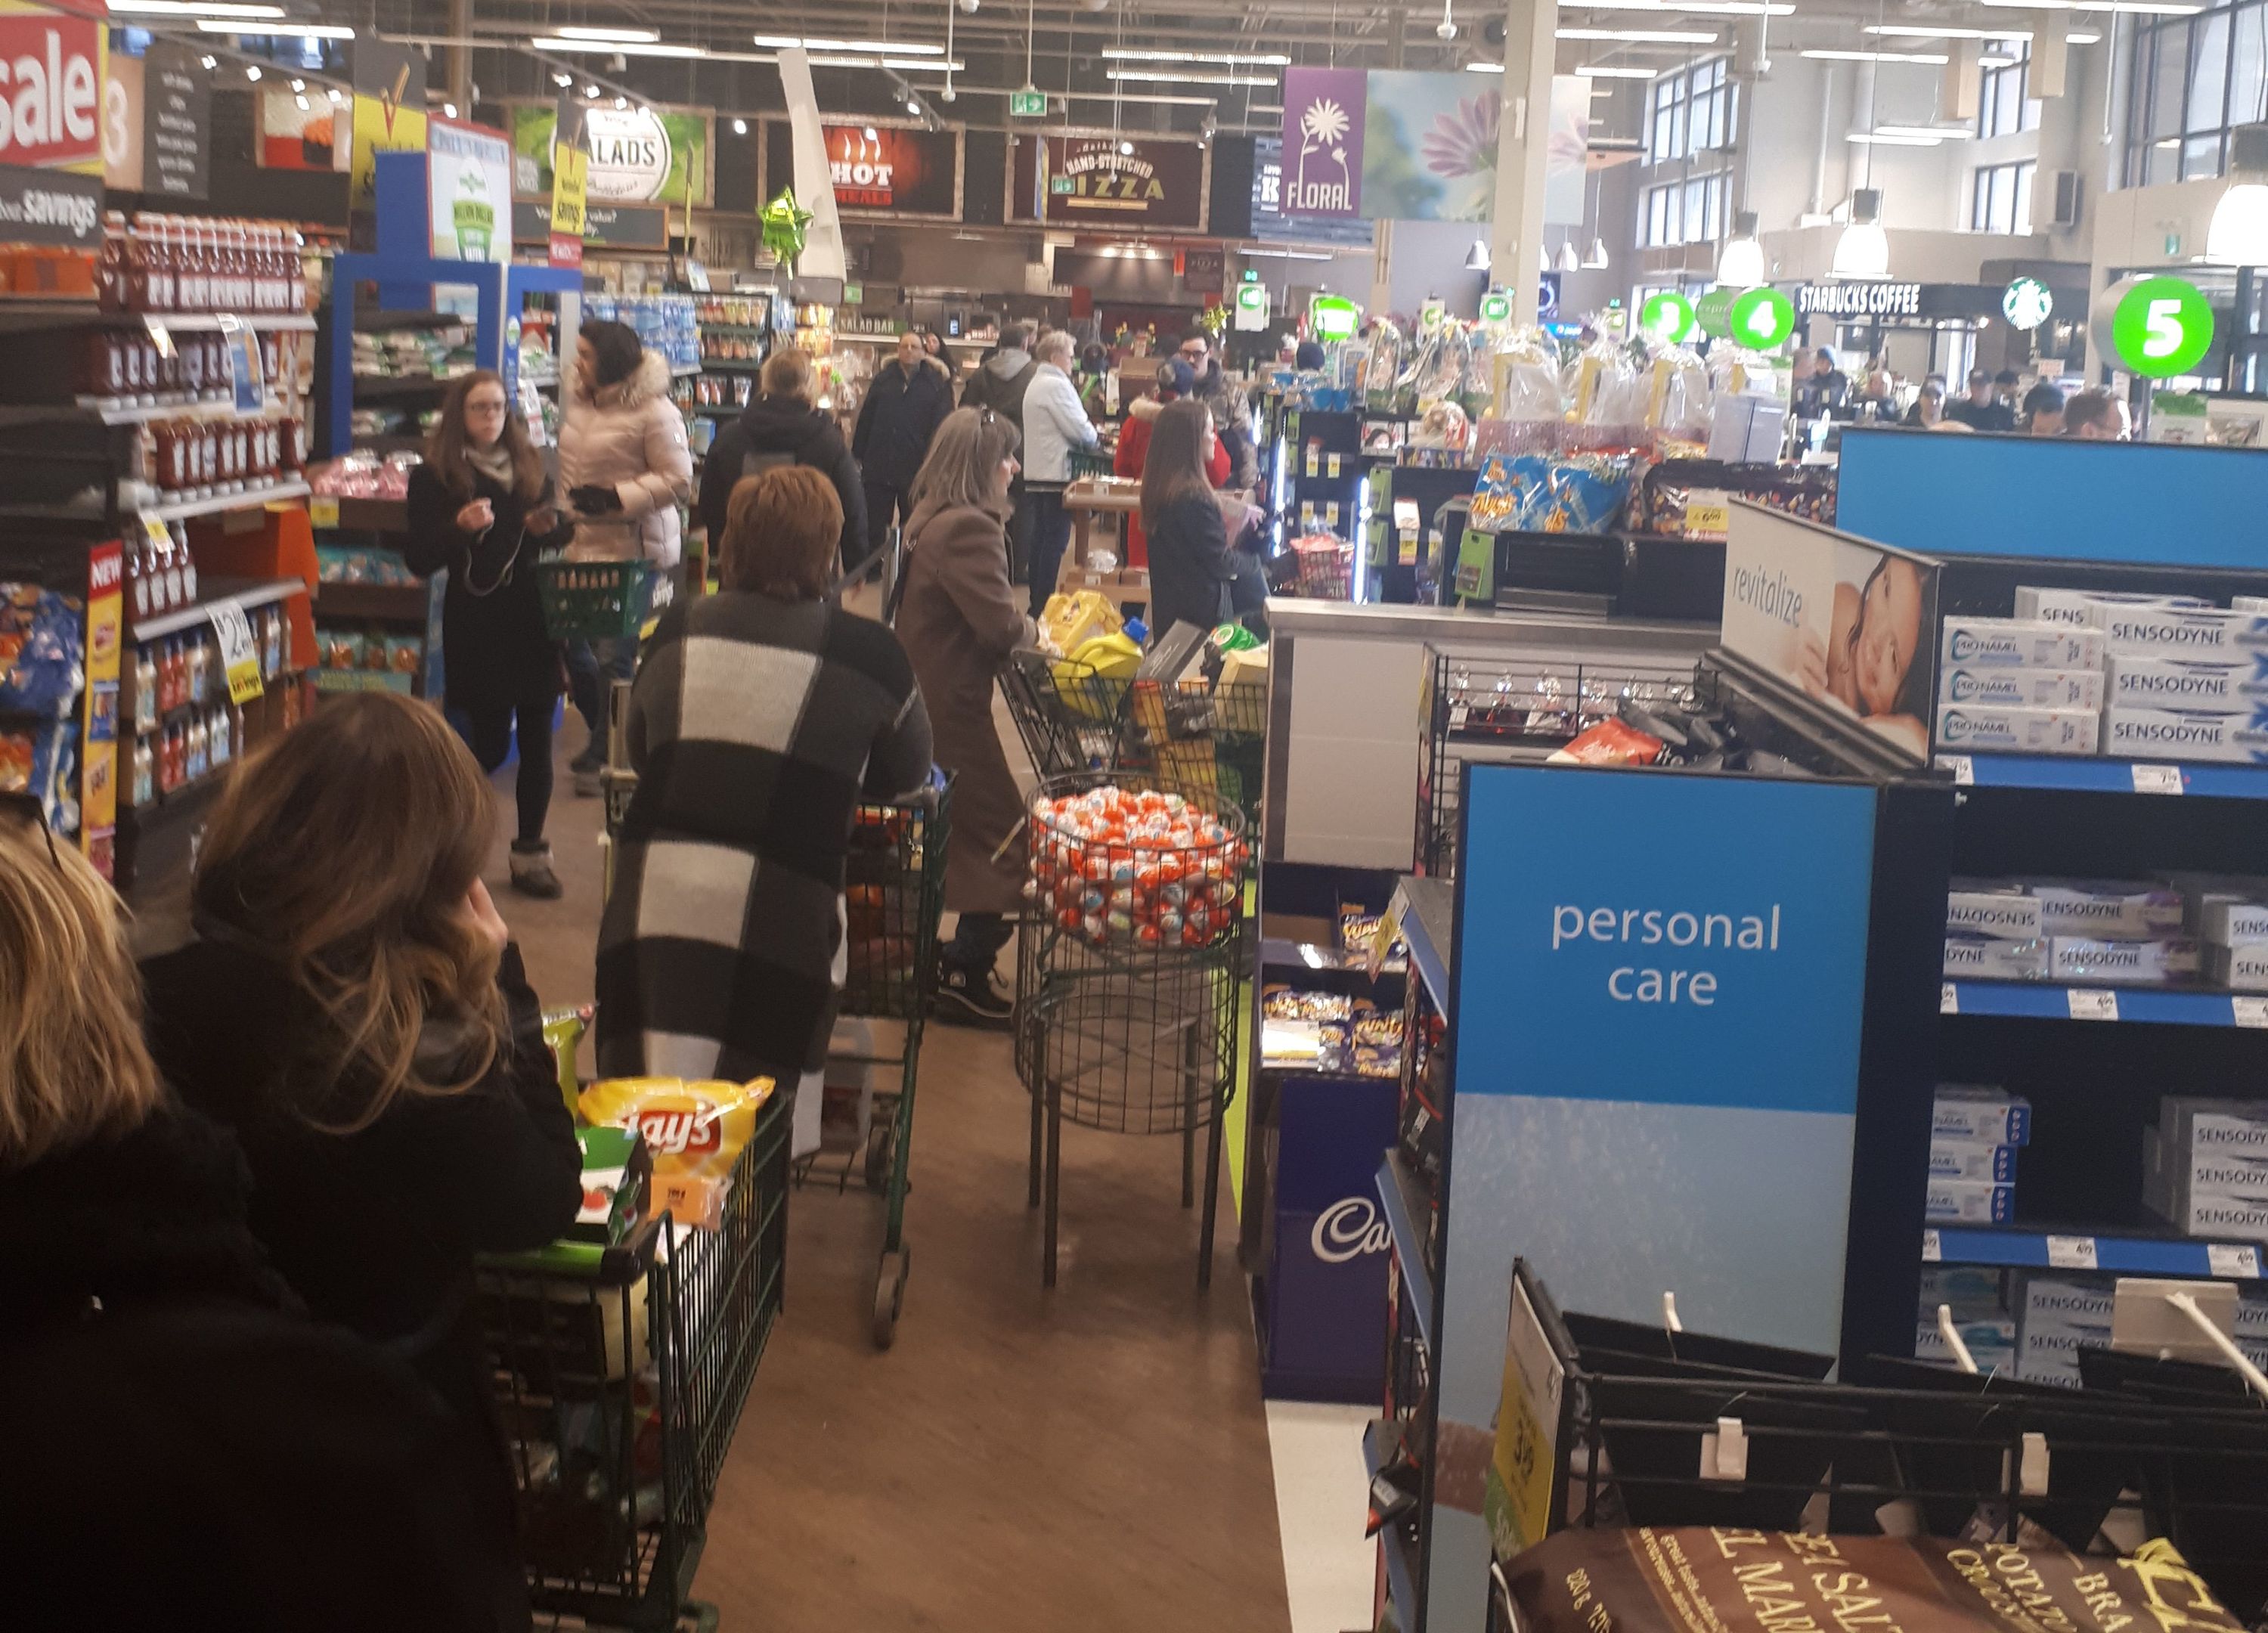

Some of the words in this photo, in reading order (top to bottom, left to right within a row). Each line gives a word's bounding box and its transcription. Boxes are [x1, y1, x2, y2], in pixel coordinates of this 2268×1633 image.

[831, 163, 893, 186] HOT
[1077, 174, 1165, 200] IZZA
[1287, 181, 1352, 211] FLORAL
[23, 189, 96, 239] savings
[1799, 285, 1868, 313] STARBUCKS
[1869, 284, 1920, 314] COFFEE
[840, 318, 872, 333] SALAD
[874, 319, 894, 333] BAR
[1748, 301, 1777, 338] 4
[2143, 299, 2183, 357] 5
[91, 555, 122, 590] NEW
[1732, 563, 1802, 628] revitalize
[2112, 623, 2224, 644] SENSODYNE
[2120, 674, 2229, 695] SENSODYNE
[2115, 722, 2223, 743] SENSODYNE
[1552, 905, 1780, 951] personal
[1949, 908, 2036, 926] SENSODYN
[2059, 953, 2139, 966] SENSODYNE
[1608, 966, 1717, 1006] care
[2197, 1168, 2268, 1185] SENSODY
[1312, 1197, 1393, 1264] Ca
[1732, 1560, 1826, 1633] MAR
[1811, 1572, 1905, 1633] SAL
